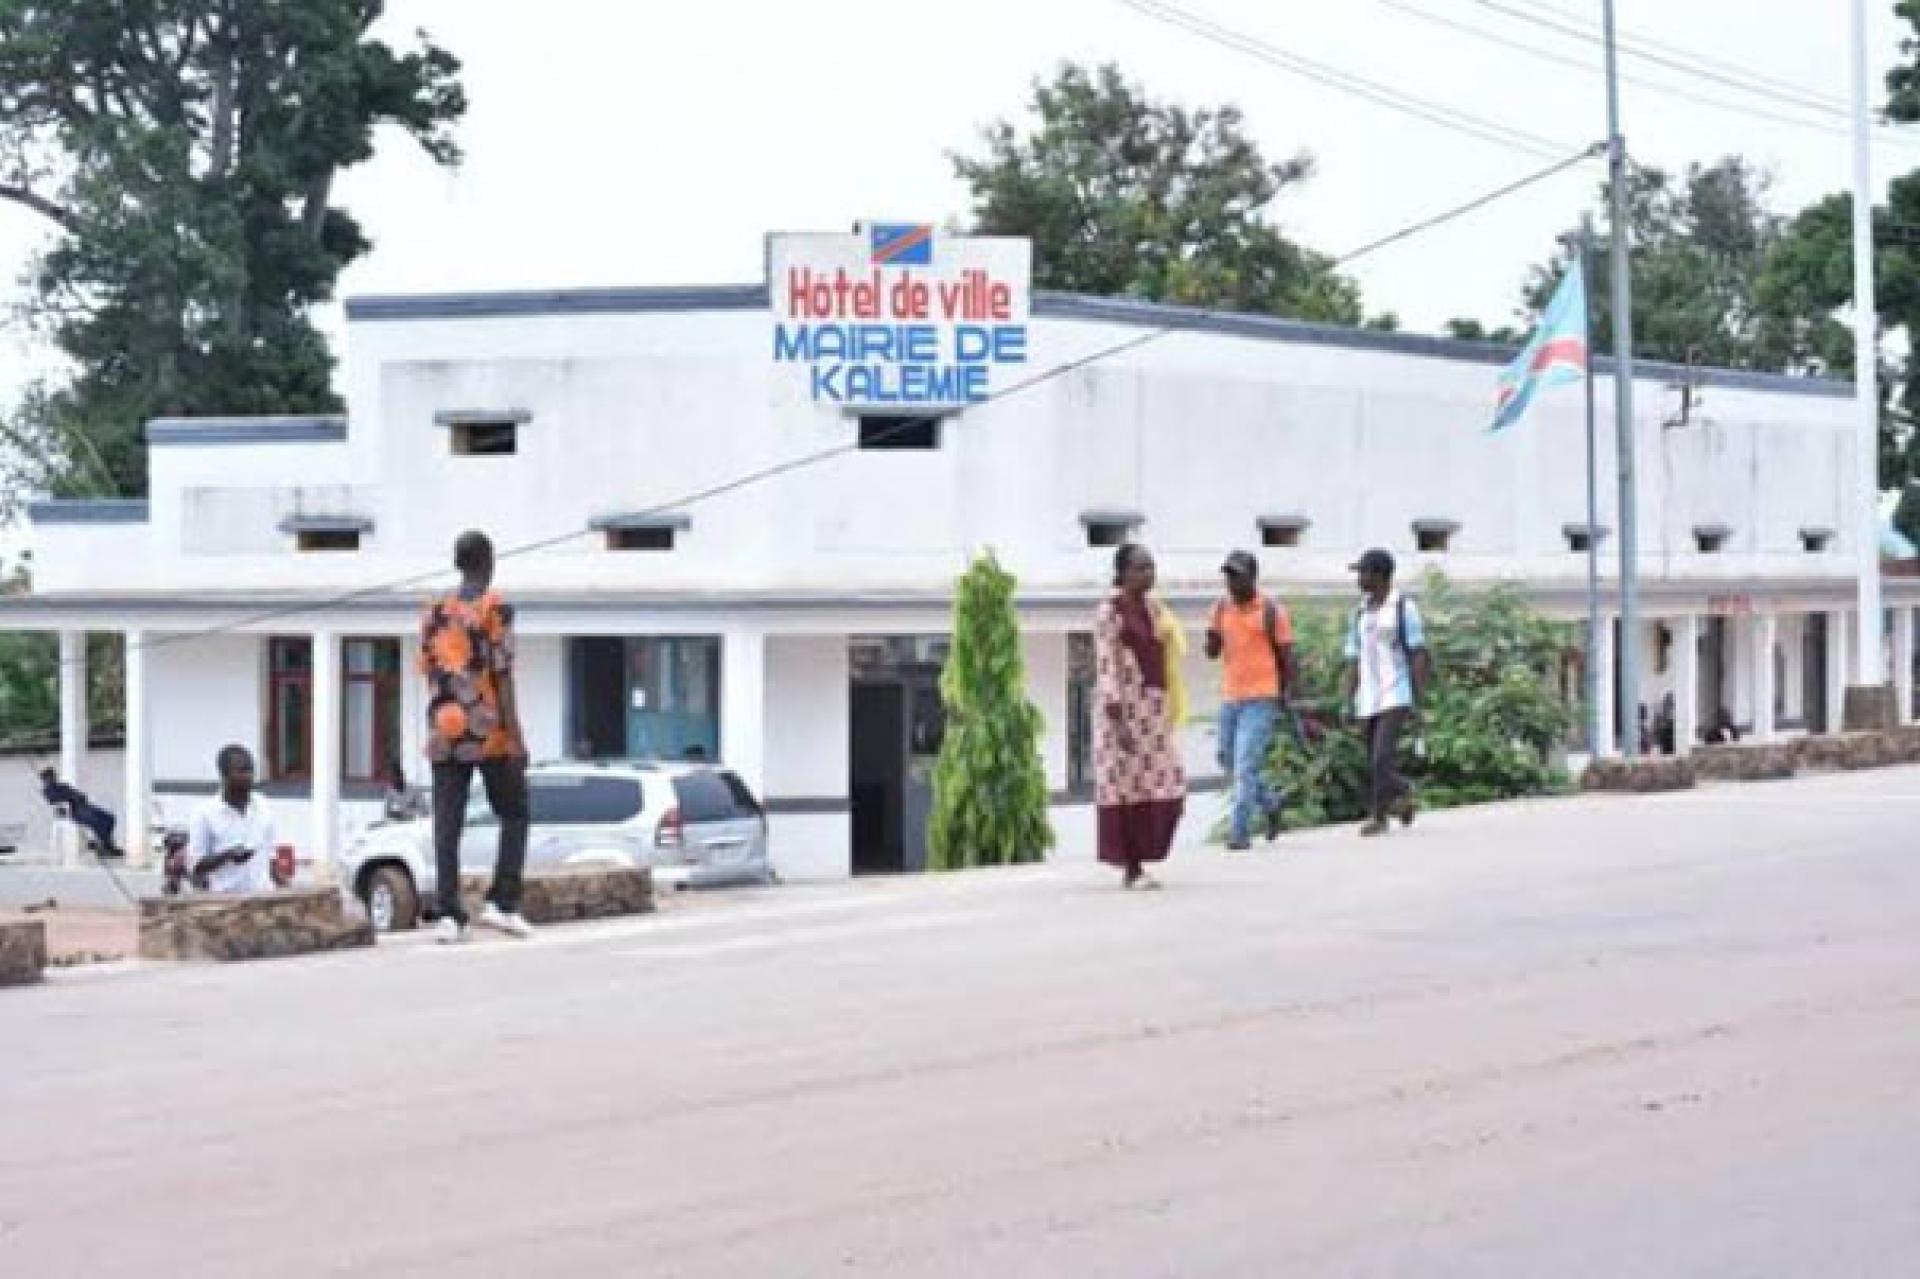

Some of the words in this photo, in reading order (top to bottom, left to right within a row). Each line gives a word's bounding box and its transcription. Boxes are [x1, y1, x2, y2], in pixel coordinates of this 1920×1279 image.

[891, 270, 929, 319] de
[939, 269, 1011, 320] ville
[773, 324, 937, 361] MAIRIE
[955, 325, 1026, 361] DE
[811, 364, 989, 401] KALEMIE
